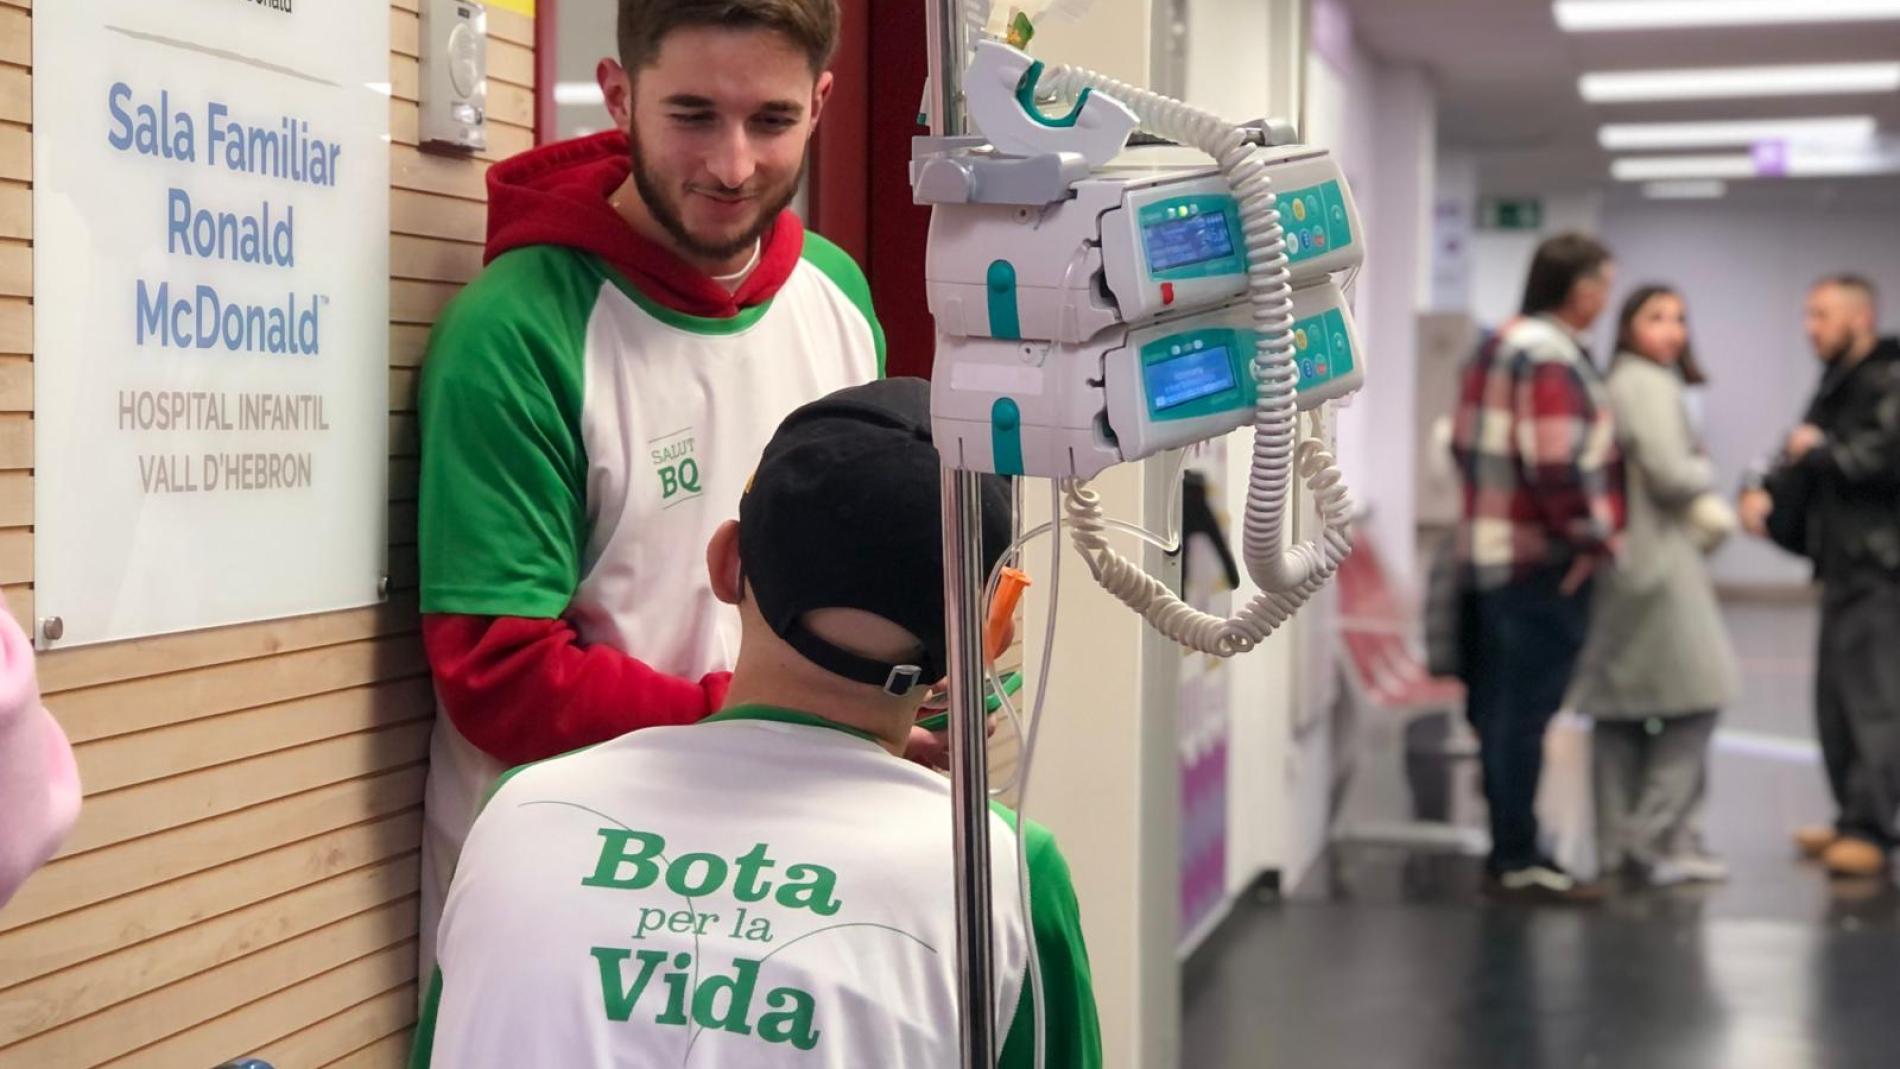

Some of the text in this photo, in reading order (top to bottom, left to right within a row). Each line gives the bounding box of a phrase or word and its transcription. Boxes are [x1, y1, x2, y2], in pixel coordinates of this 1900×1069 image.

[108, 81, 341, 187] Sala Familiar
[167, 187, 294, 268] Ronald
[118, 390, 330, 431] HOSPITAL INFANTIL
[650, 437, 694, 465] SALUT
[138, 452, 312, 494] VALL D'HEBRON
[657, 457, 702, 499] BQ
[581, 828, 842, 916] Bota
[632, 906, 774, 942] per la
[590, 946, 820, 1050] Vida
